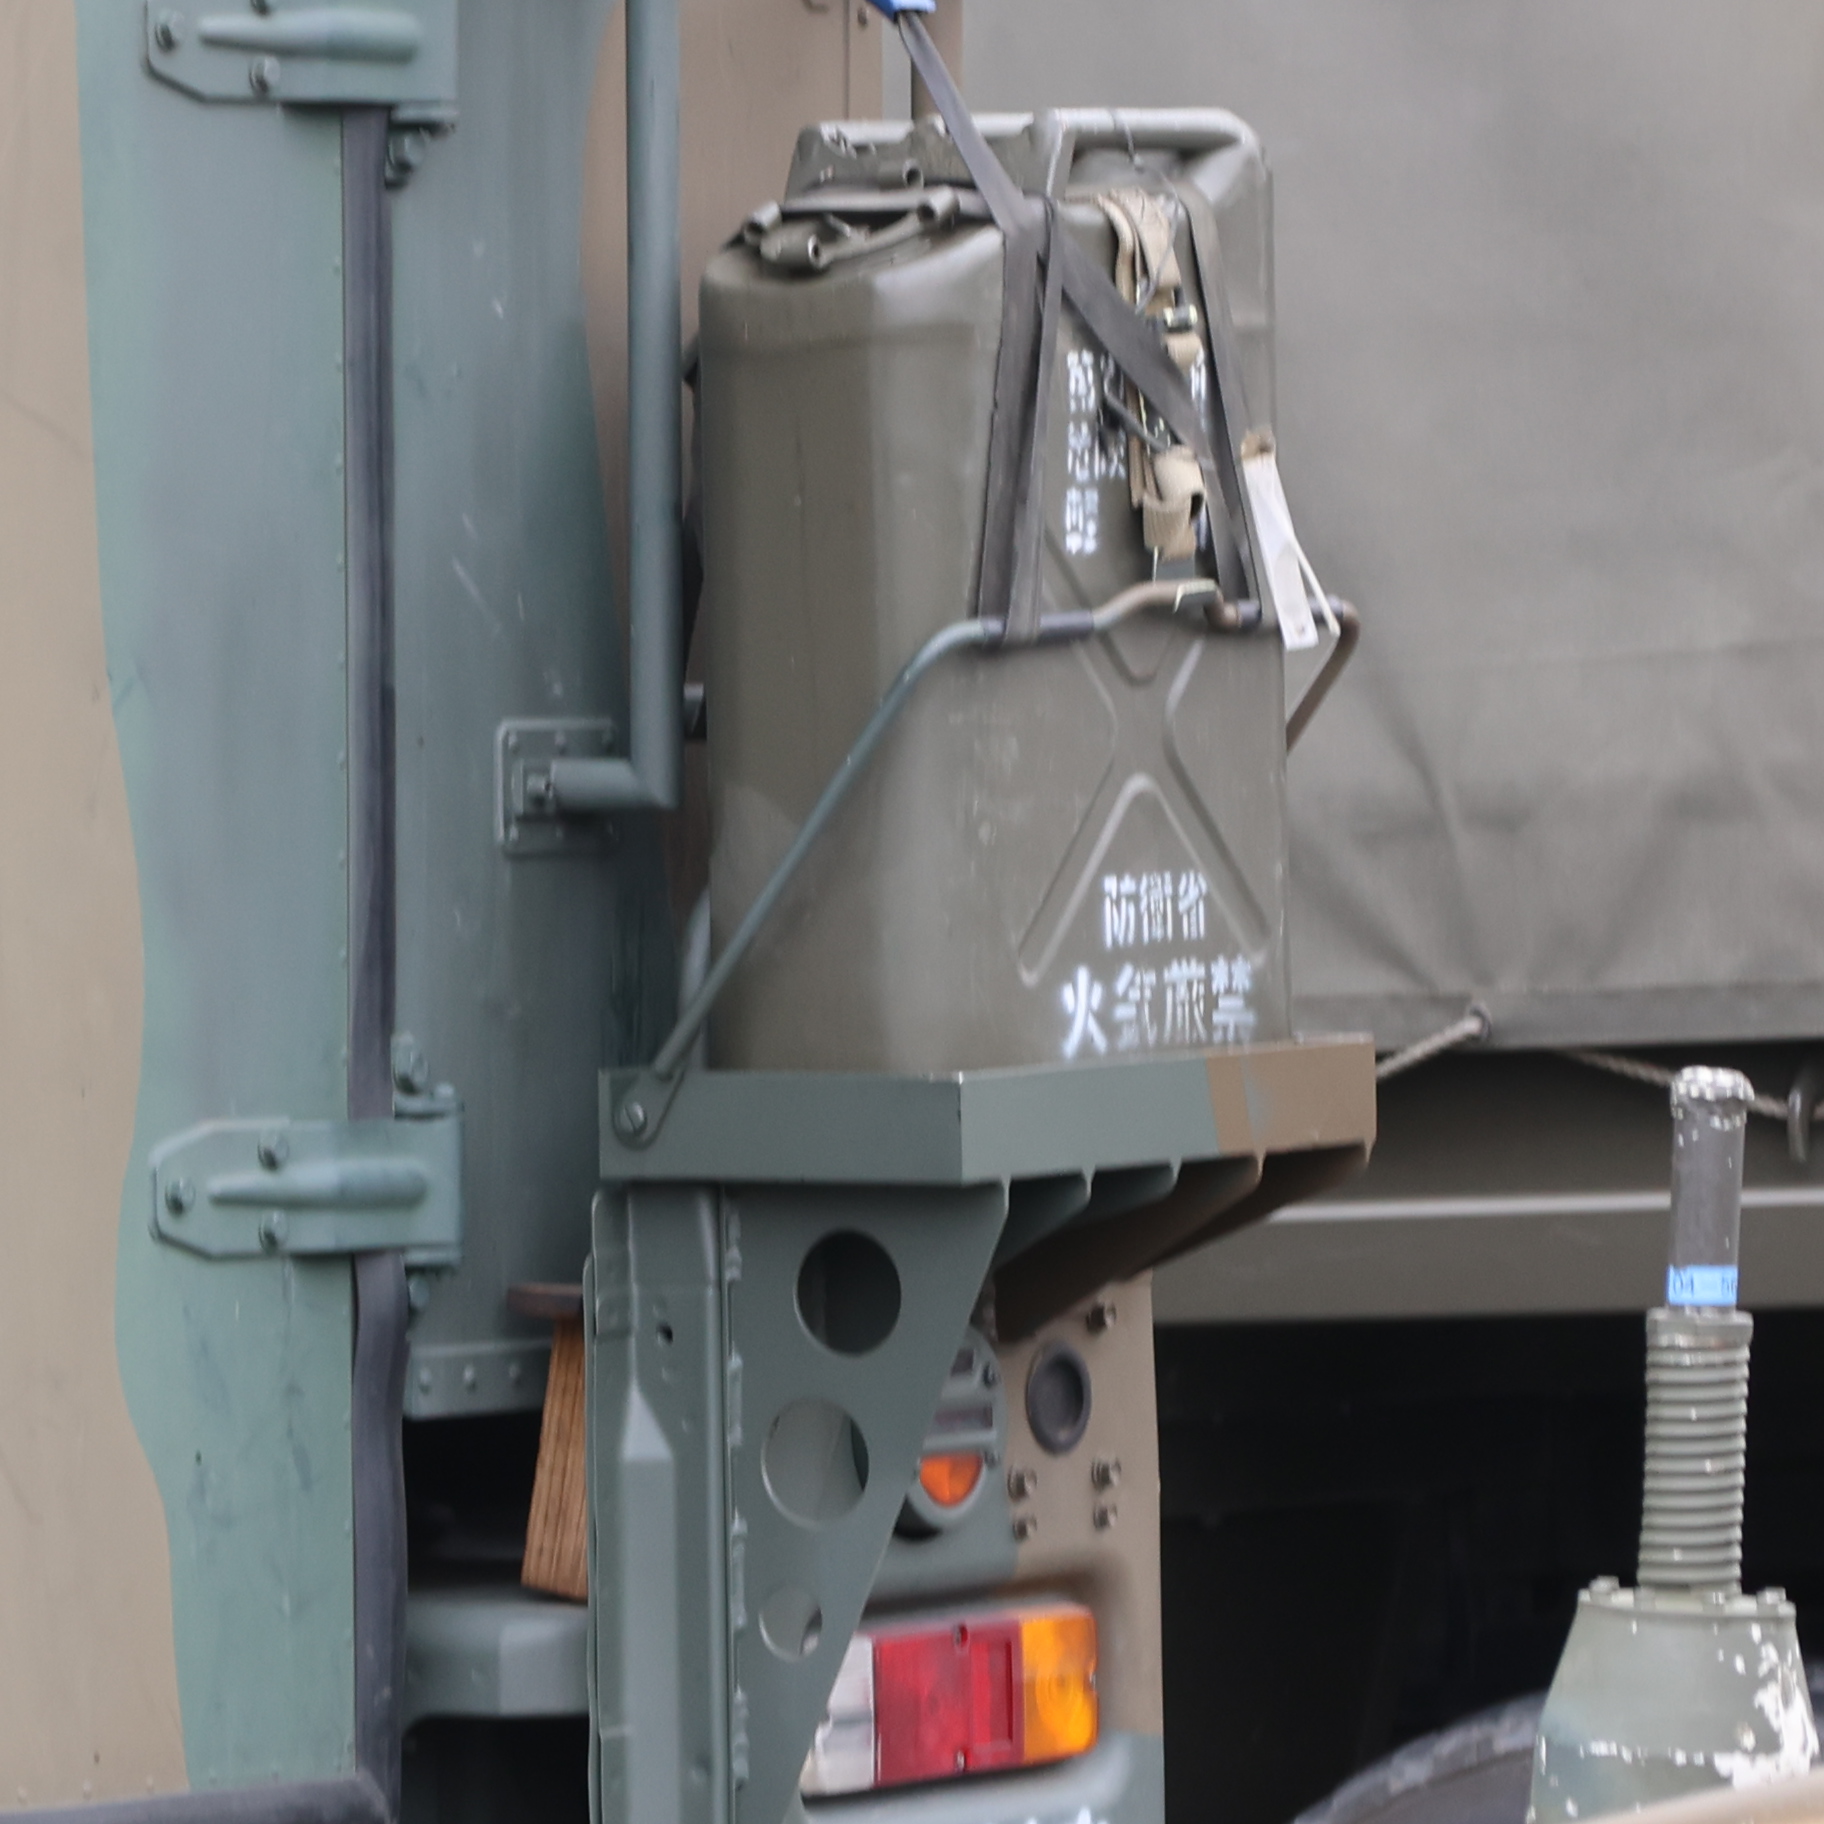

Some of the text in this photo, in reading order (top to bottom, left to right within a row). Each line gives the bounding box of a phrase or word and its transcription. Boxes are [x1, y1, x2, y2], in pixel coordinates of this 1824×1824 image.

[1103, 869, 1208, 949] 防衛省
[1062, 952, 1256, 1061] 火気厳禁
